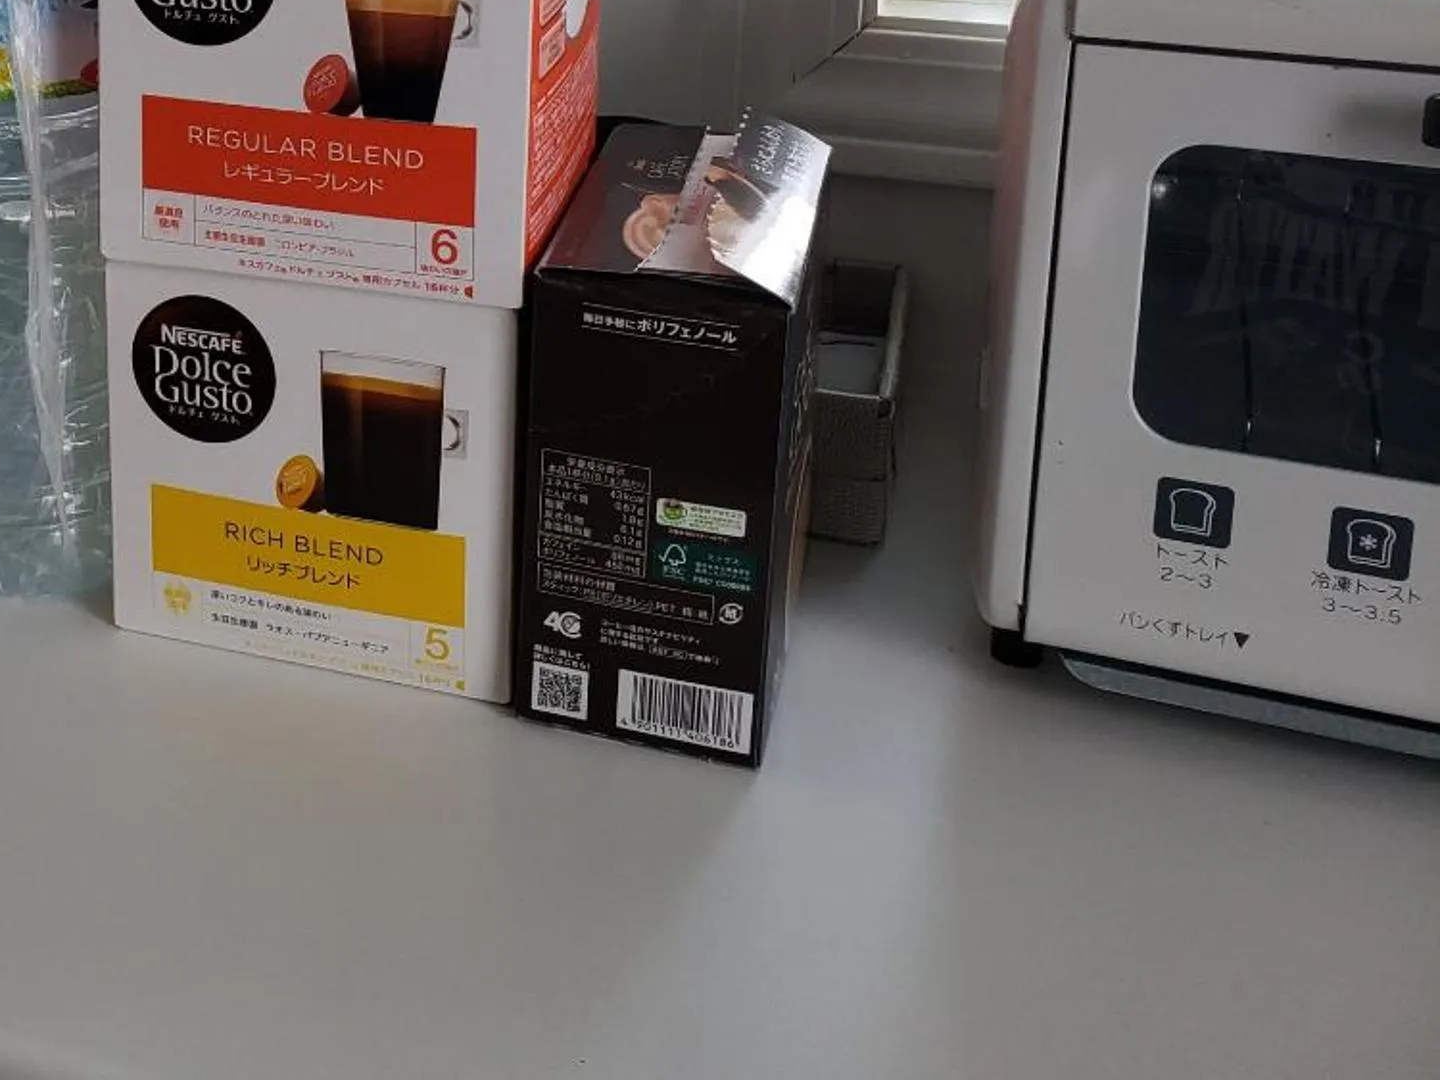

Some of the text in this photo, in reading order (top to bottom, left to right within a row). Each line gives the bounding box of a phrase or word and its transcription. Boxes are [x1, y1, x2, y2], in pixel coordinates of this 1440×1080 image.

[187, 125, 425, 170] REGULAR BLEND
[223, 161, 385, 196] レギュラーブレンド
[431, 228, 458, 265] 6
[150, 344, 253, 388] Dolce
[154, 373, 253, 415] Gusto
[225, 521, 384, 566] RICH BLEND
[1156, 542, 1231, 570] トースト
[246, 556, 361, 589] リッチブレンド
[1310, 570, 1423, 605] 冷凍トースト
[424, 627, 450, 660] 5
